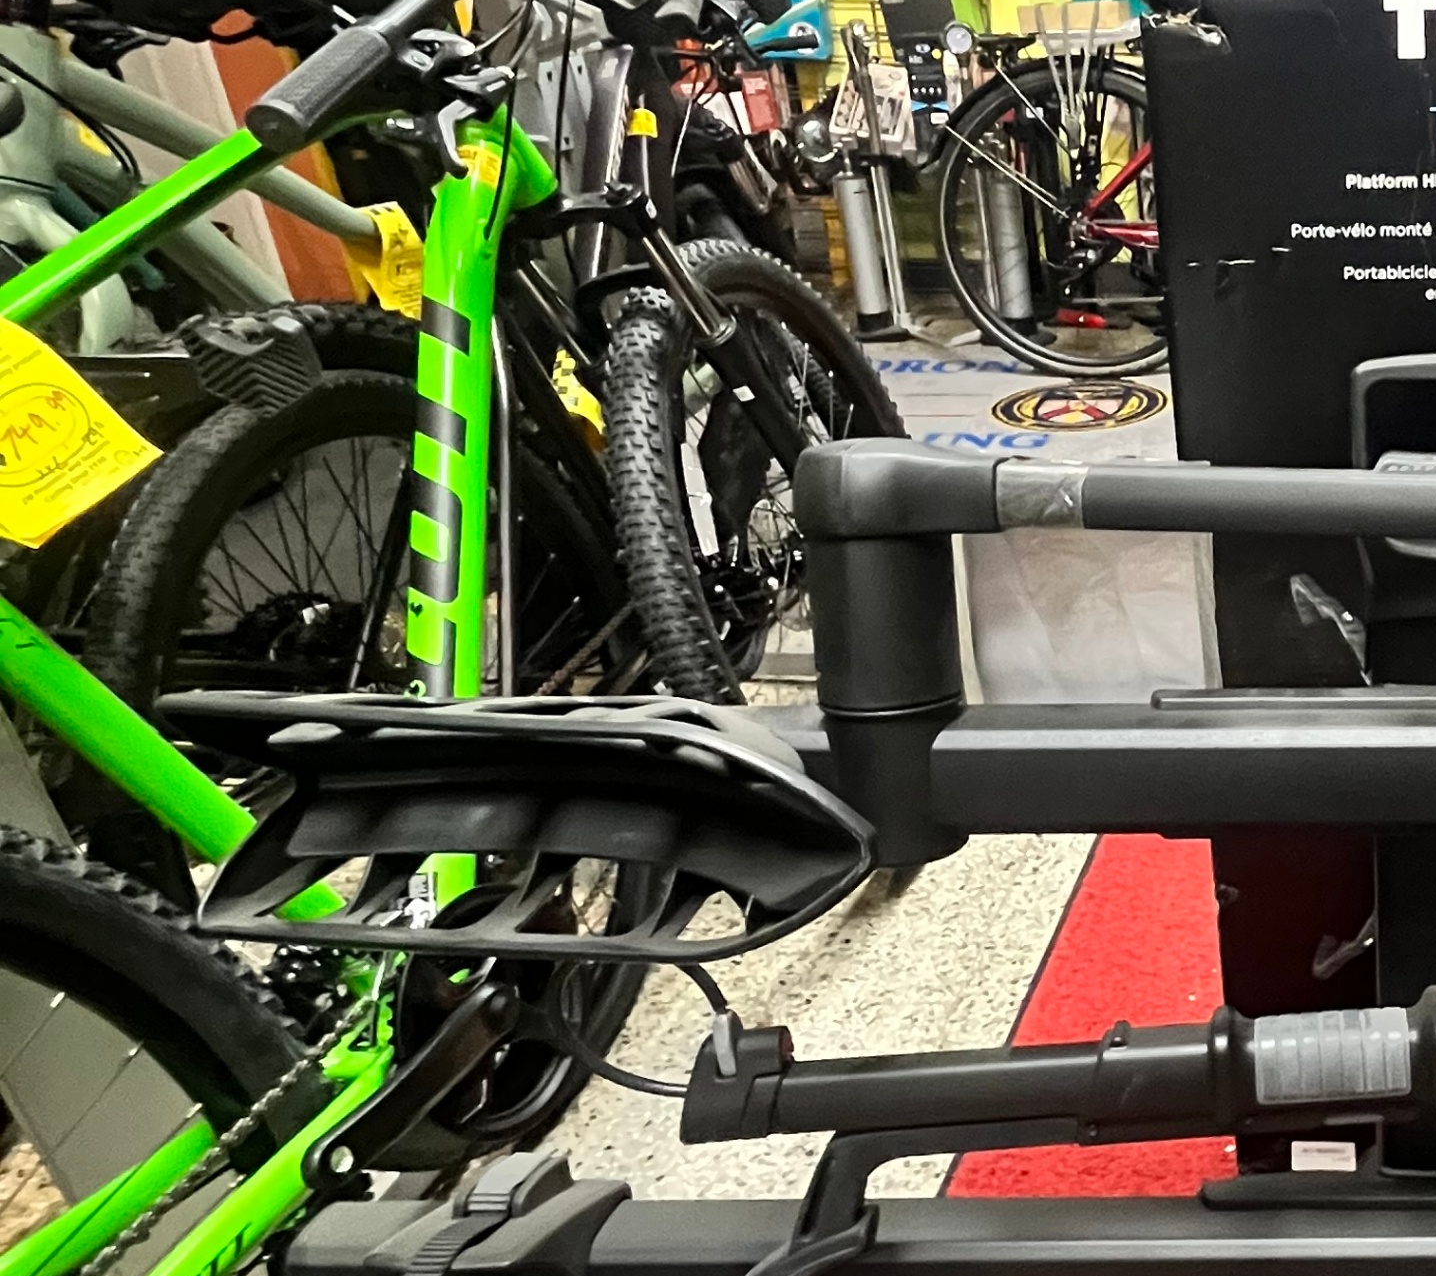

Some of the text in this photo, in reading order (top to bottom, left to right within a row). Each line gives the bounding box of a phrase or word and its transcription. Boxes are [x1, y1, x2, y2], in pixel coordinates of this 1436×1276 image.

[1345, 173, 1419, 190] Platform
[1290, 222, 1376, 239] Porte-vélo
[1379, 221, 1433, 237] monté
